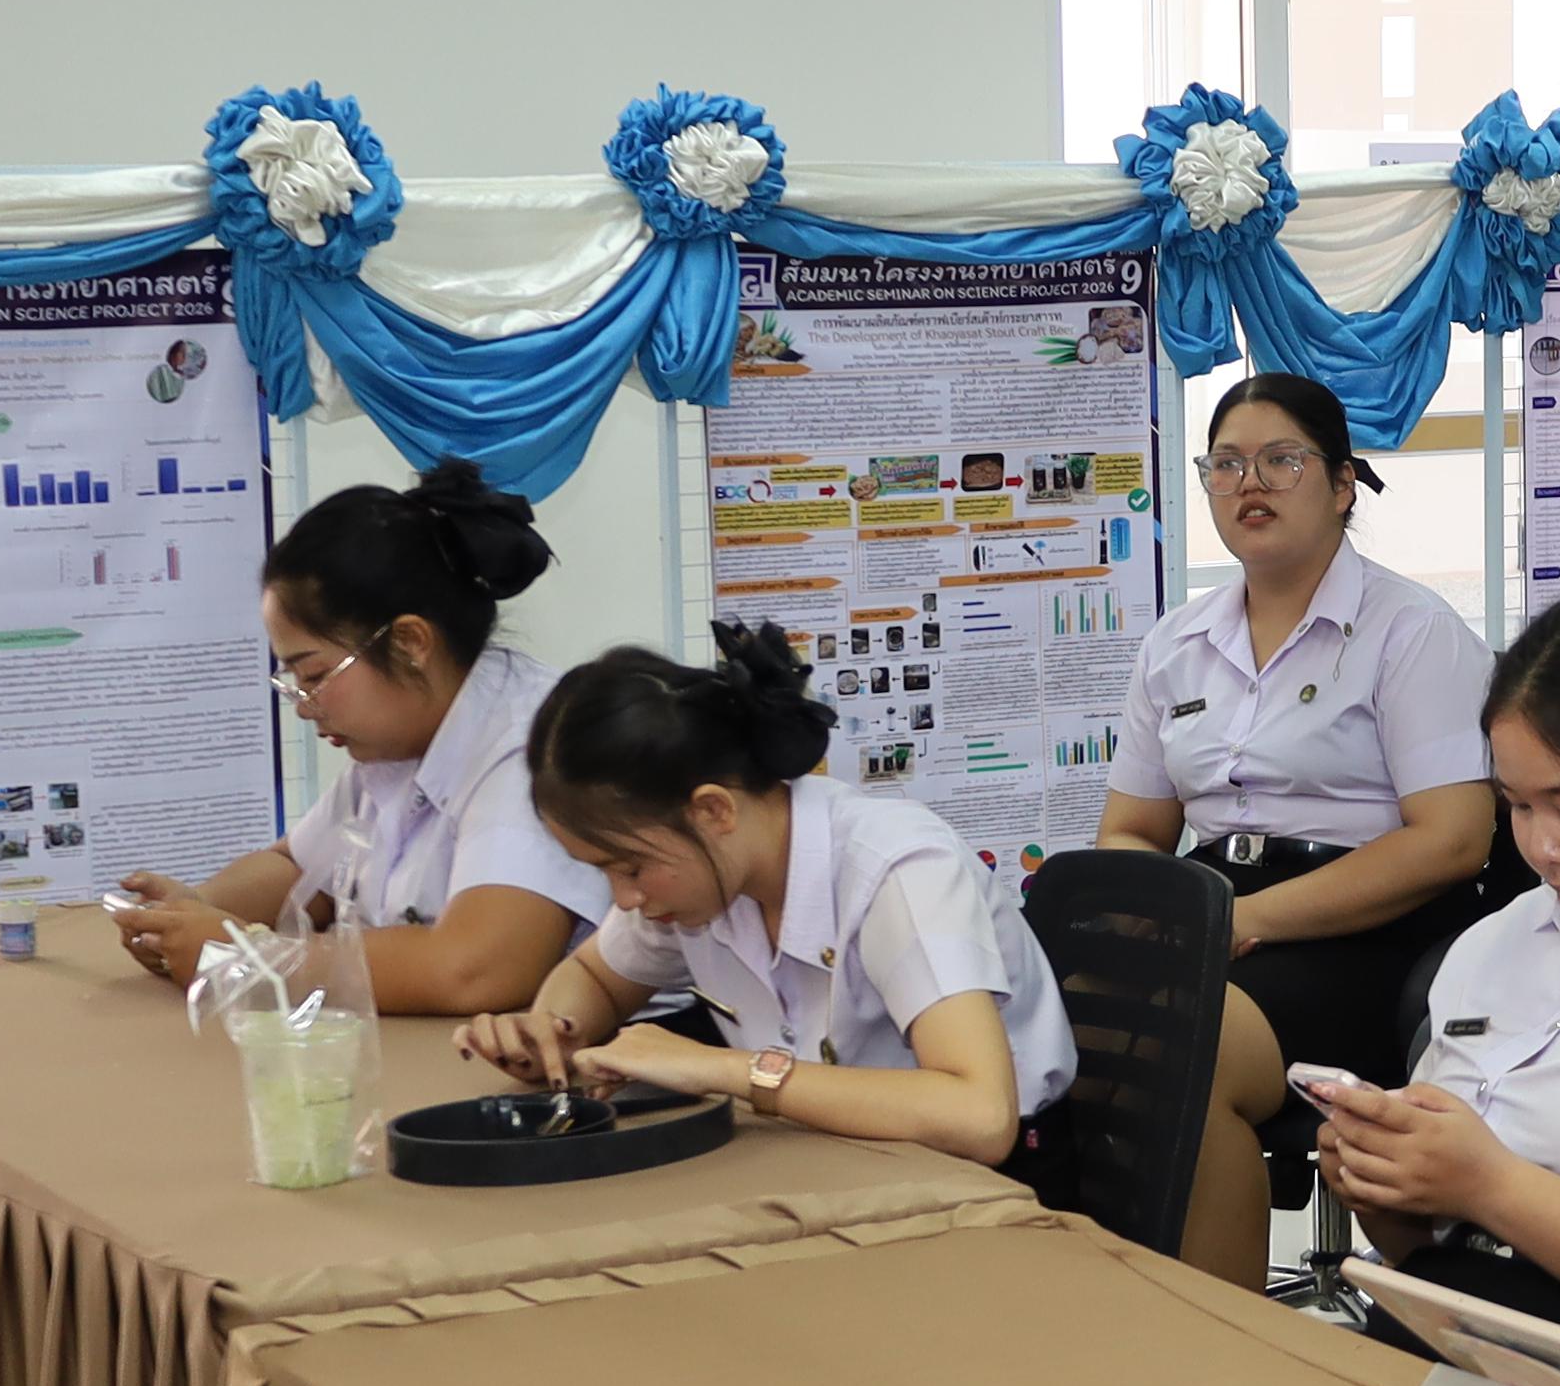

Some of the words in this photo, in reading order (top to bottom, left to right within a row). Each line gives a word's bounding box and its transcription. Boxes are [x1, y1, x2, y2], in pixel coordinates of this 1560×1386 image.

[1120, 259, 1143, 295] 9
[786, 287, 865, 303] ACADEMIC
[867, 288, 930, 301] SEMINAR
[933, 287, 954, 300] ON
[957, 285, 1017, 299] SCIENCE
[1020, 283, 1078, 297] PROJECT
[1082, 281, 1115, 294] 2026
[15, 303, 89, 321] SCIENCE
[92, 302, 171, 318] PROJECT
[174, 301, 215, 317] 2026
[808, 331, 831, 344] The
[833, 330, 907, 346] Development
[910, 330, 923, 341] of
[984, 325, 1016, 339] Stout
[1018, 324, 1047, 337] Craft
[1049, 322, 1076, 336] Beer
